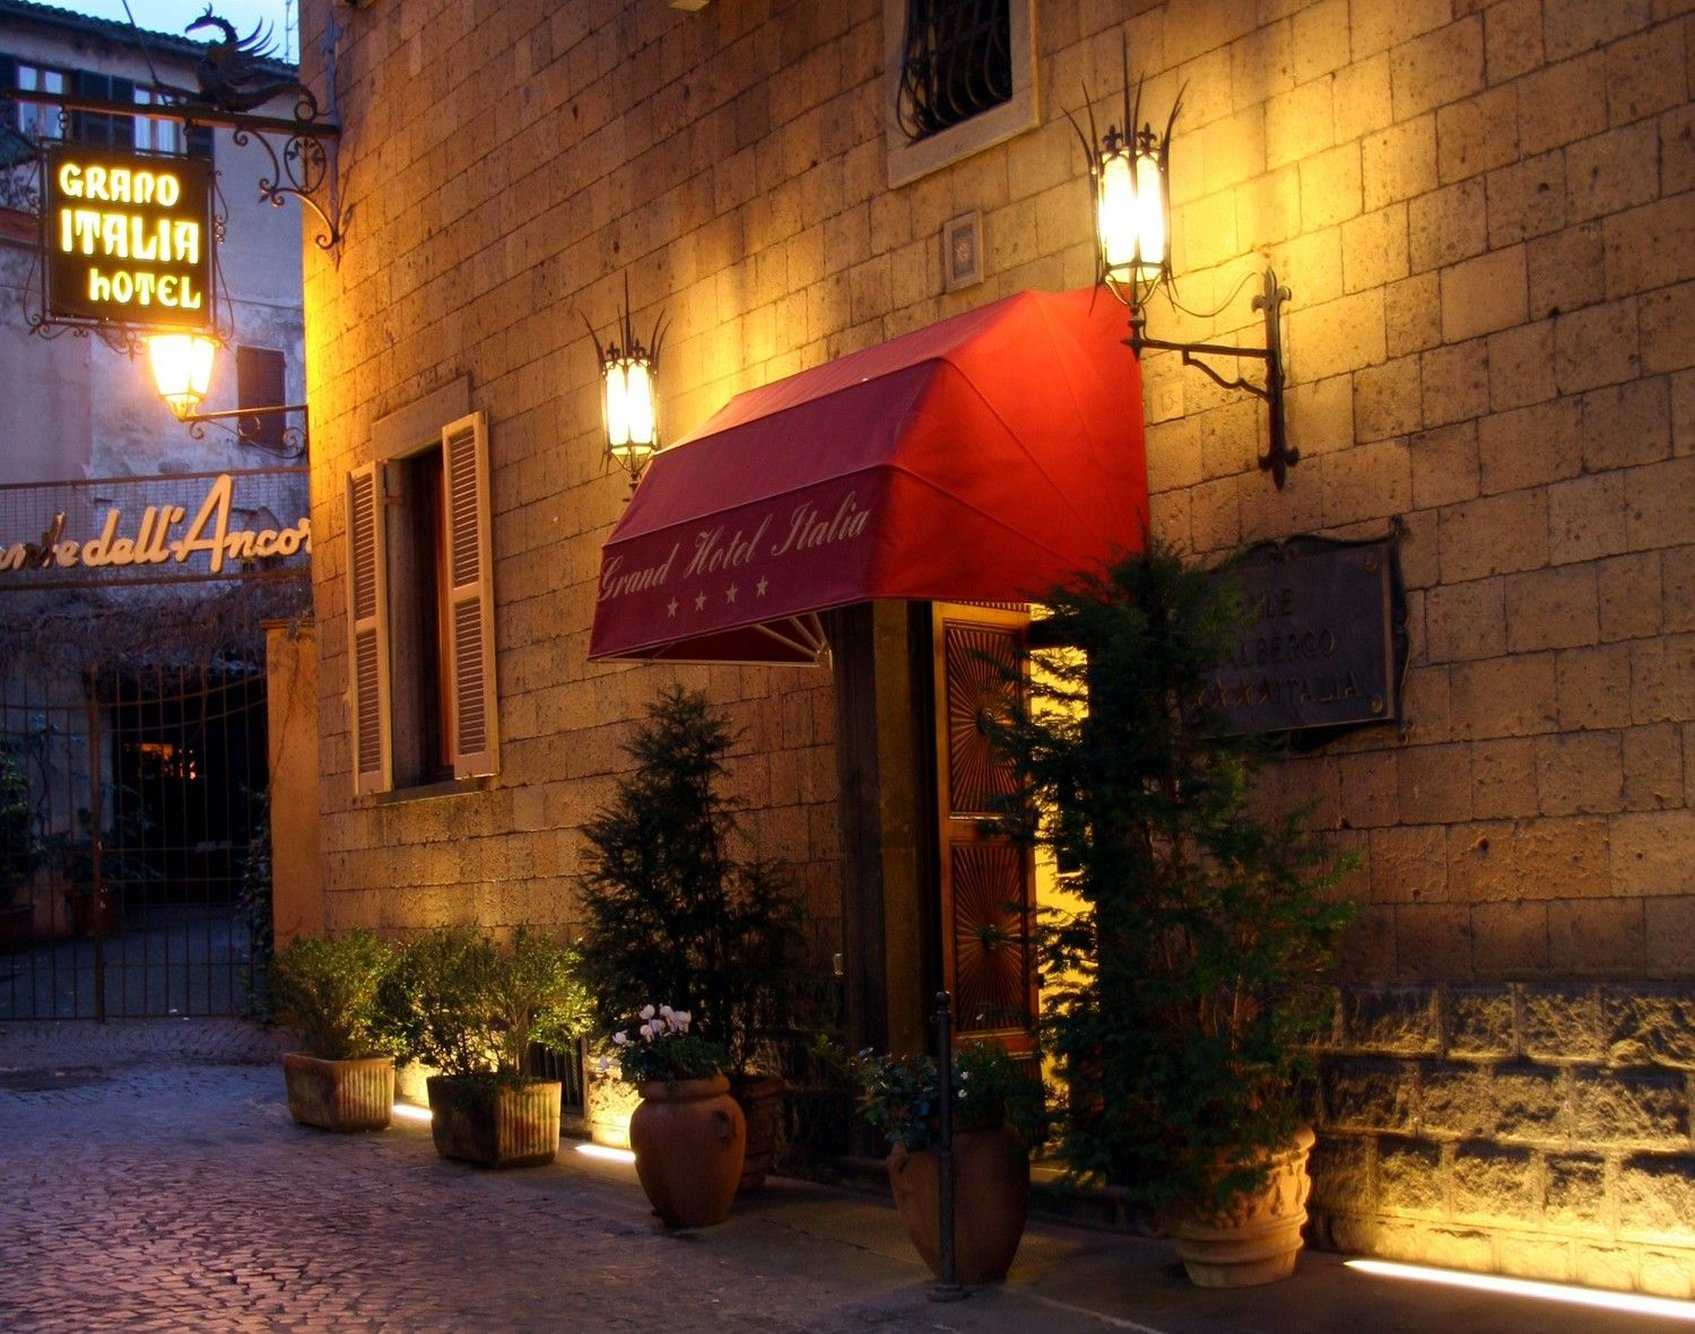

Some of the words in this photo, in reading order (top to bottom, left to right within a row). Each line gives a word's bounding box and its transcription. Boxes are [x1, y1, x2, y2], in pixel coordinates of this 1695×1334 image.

[61, 209, 199, 264] ITALIA
[600, 542, 680, 601] Grand
[683, 513, 773, 578] Hotel
[770, 490, 872, 557] Italia
